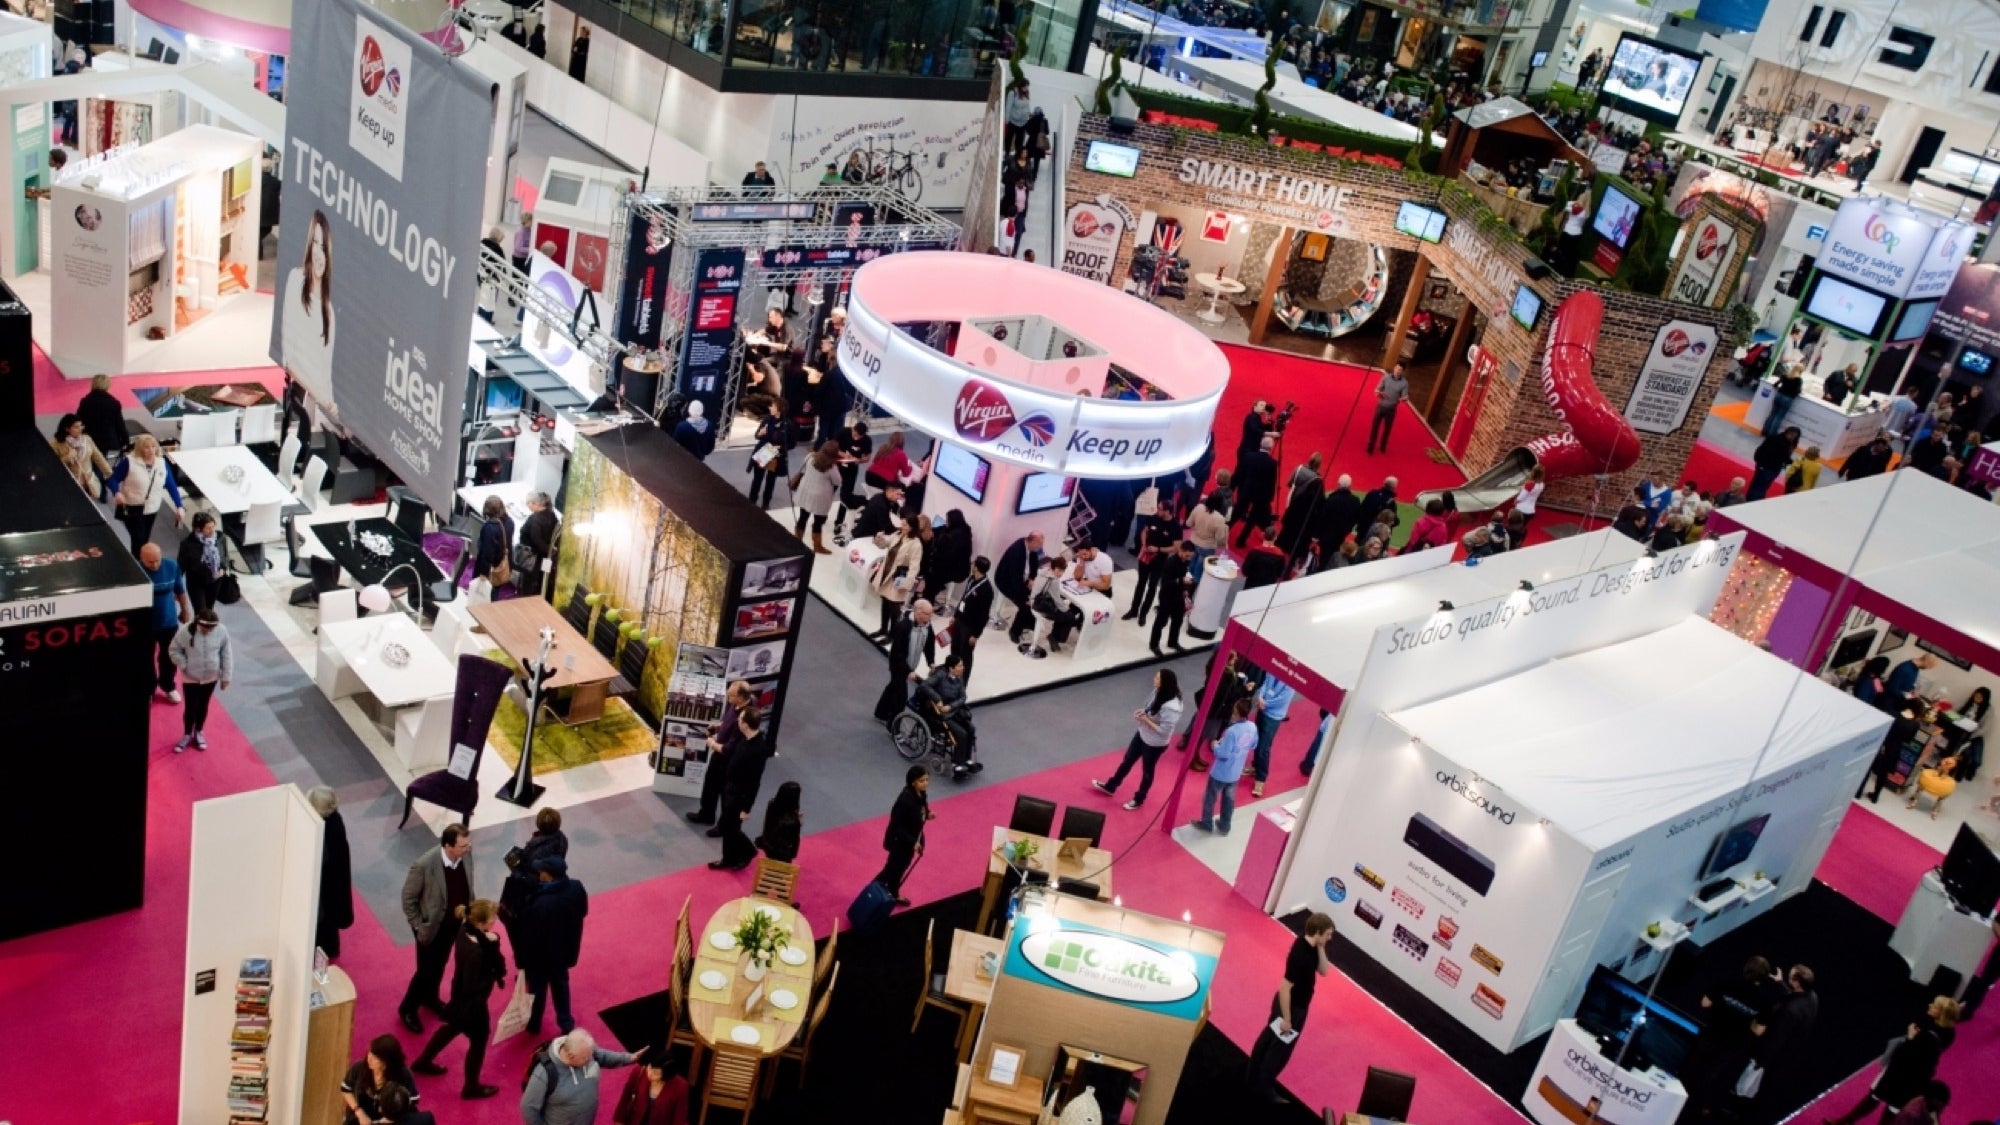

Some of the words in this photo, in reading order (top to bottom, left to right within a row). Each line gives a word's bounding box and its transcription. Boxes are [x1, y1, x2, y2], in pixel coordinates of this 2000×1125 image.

[357, 106, 381, 138] Keep
[383, 128, 395, 147] up
[834, 125, 856, 142] Quiet
[857, 117, 904, 131] Revolution
[1179, 157, 1273, 197] SMART
[1276, 175, 1353, 212] HOME
[292, 136, 456, 299] TECHNOLOGY
[1064, 249, 1109, 270] ROOF
[1448, 222, 1488, 271] SMART
[1483, 252, 1520, 303] HOME
[1828, 256, 1859, 274] made
[1860, 267, 1896, 288] simple
[1831, 240, 1869, 265] Energy
[1871, 256, 1905, 279] saving
[862, 353, 881, 377] up
[385, 337, 444, 437] ideal
[1644, 380, 1689, 396] STANDARD
[384, 387, 413, 423] HOME
[413, 414, 442, 451] SHOW
[956, 385, 1012, 438] Virgin
[996, 442, 1044, 464] media
[1065, 428, 1128, 459] Keep
[1136, 436, 1163, 463] up
[1387, 622, 1453, 655] Studio
[1457, 601, 1518, 642] quality
[1522, 578, 1582, 617] Sound.
[1590, 562, 1665, 595] Designed
[1665, 552, 1691, 576] for
[1691, 543, 1736, 569] Living
[24, 617, 129, 651] SOFAS
[1436, 770, 1517, 825] orbitsound
[1431, 874, 1446, 888] for
[1445, 885, 1469, 908] living
[1567, 1047, 1653, 1104] orbitsound
